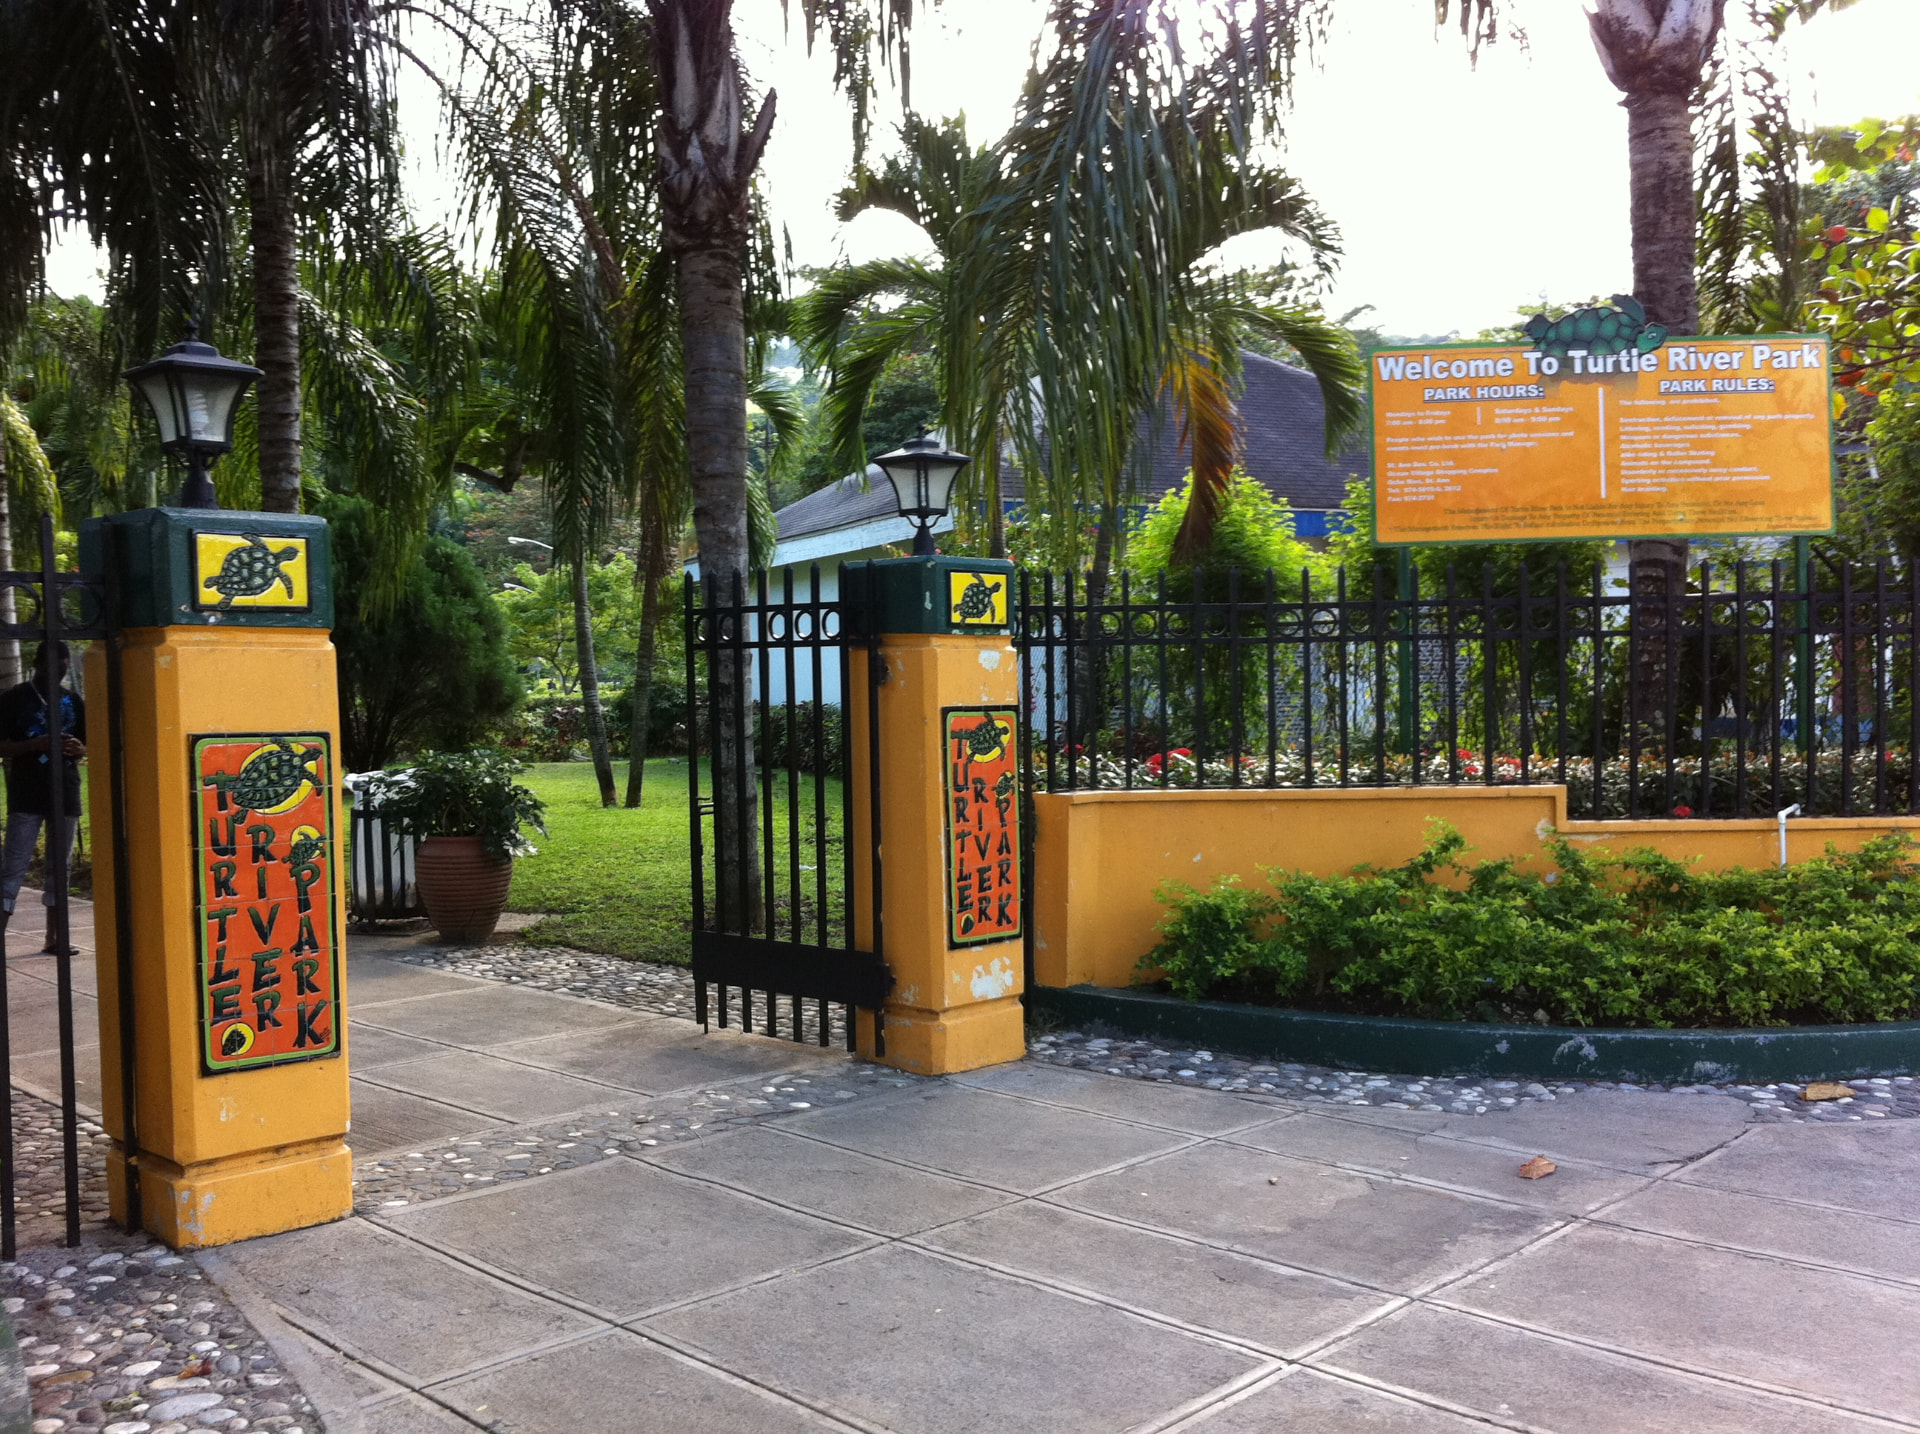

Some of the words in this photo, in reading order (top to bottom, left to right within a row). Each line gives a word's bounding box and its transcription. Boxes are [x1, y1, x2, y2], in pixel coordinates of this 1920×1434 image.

[1376, 354, 1514, 381] Welcome
[1522, 351, 1559, 375] To
[1567, 348, 1658, 374] Turtle
[1668, 345, 1745, 371] River
[1753, 343, 1821, 369] Park
[1424, 386, 1471, 400] PARK
[1476, 384, 1544, 399] HOURS:
[1660, 379, 1707, 393] PARK
[1712, 378, 1775, 392] RULES:
[951, 728, 973, 915] TURTLE
[972, 777, 993, 924] RIVER
[996, 798, 1013, 927] PARK
[203, 769, 242, 1024] TURTLE
[246, 823, 283, 1032] RIVER
[292, 863, 328, 1049] PARK
